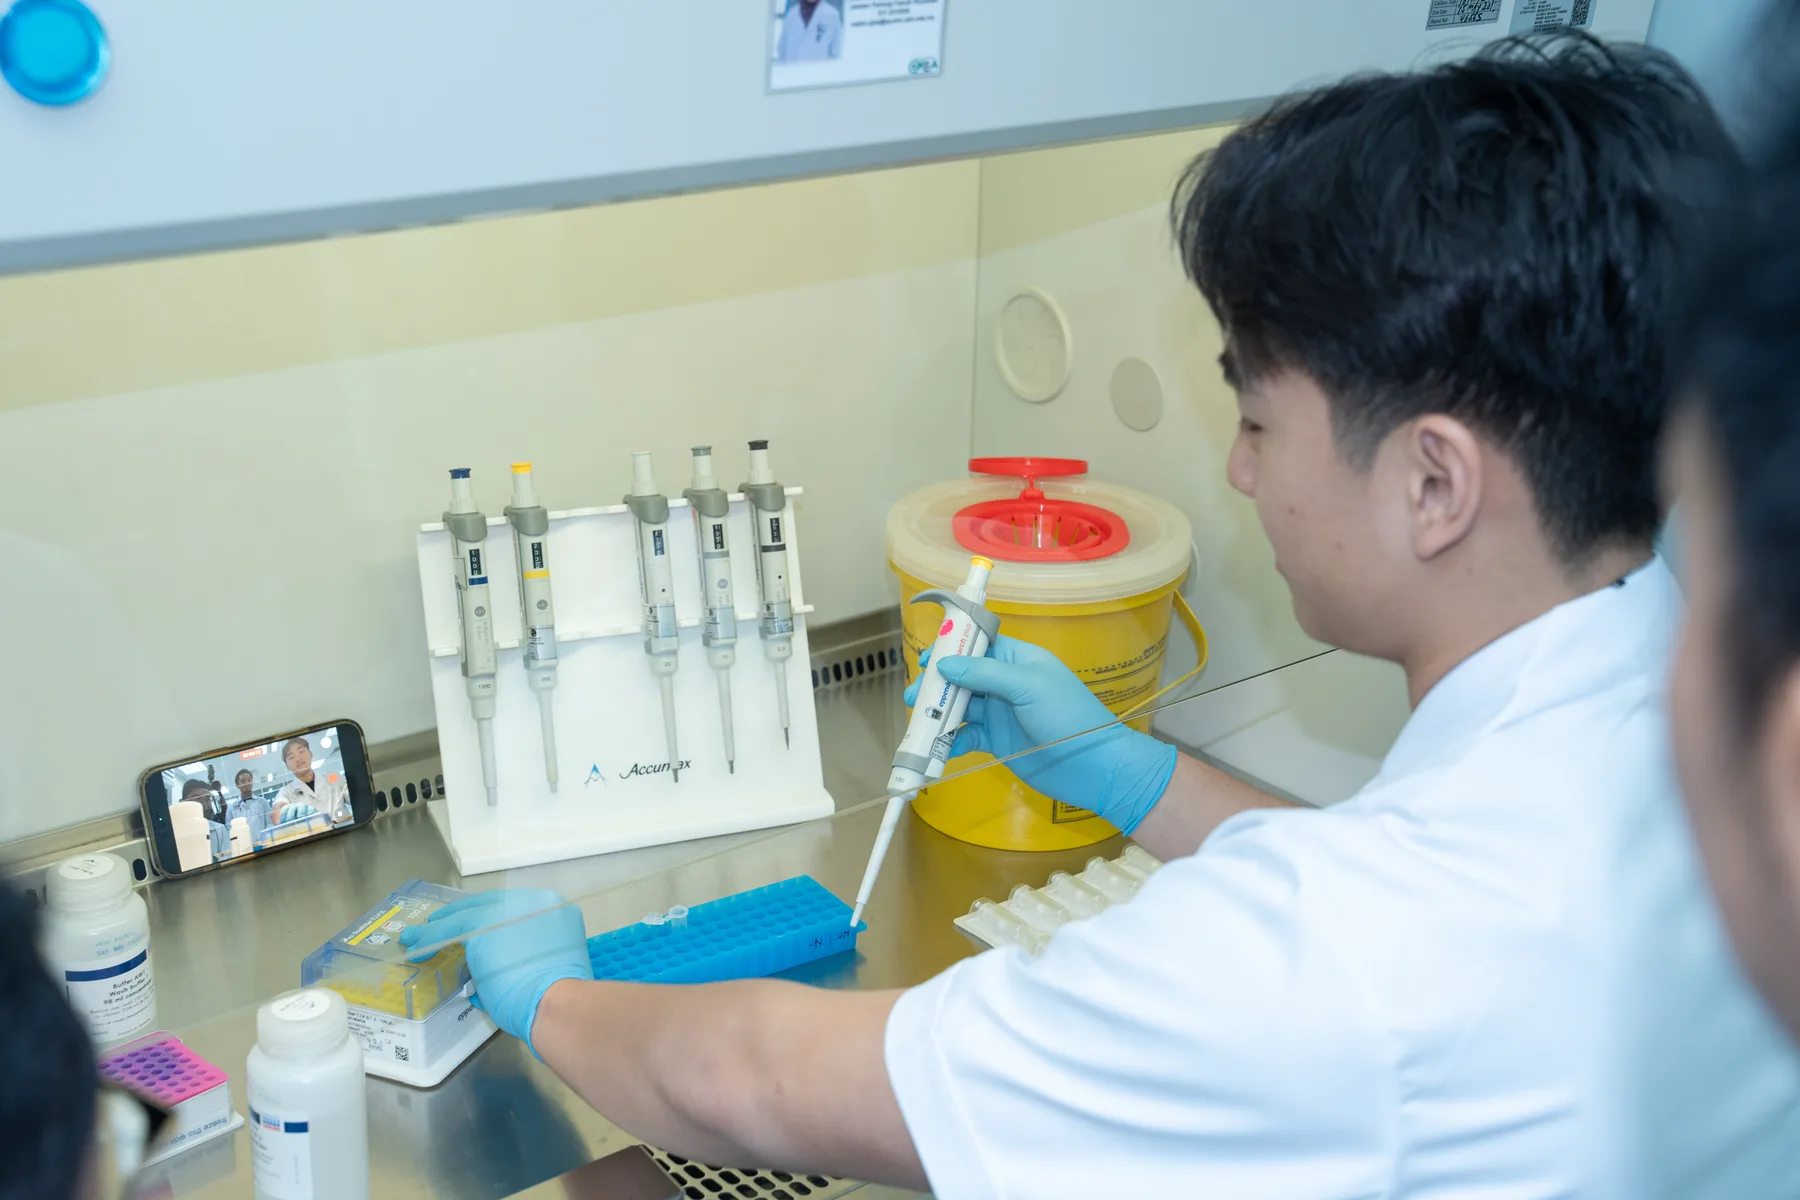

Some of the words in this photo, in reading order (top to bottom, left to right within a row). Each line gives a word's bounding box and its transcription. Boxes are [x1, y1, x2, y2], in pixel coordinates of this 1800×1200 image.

[938, 681, 951, 708] eppend
[112, 978, 133, 990] Buffer
[109, 987, 129, 998] Wash
[103, 998, 114, 1006] 98
